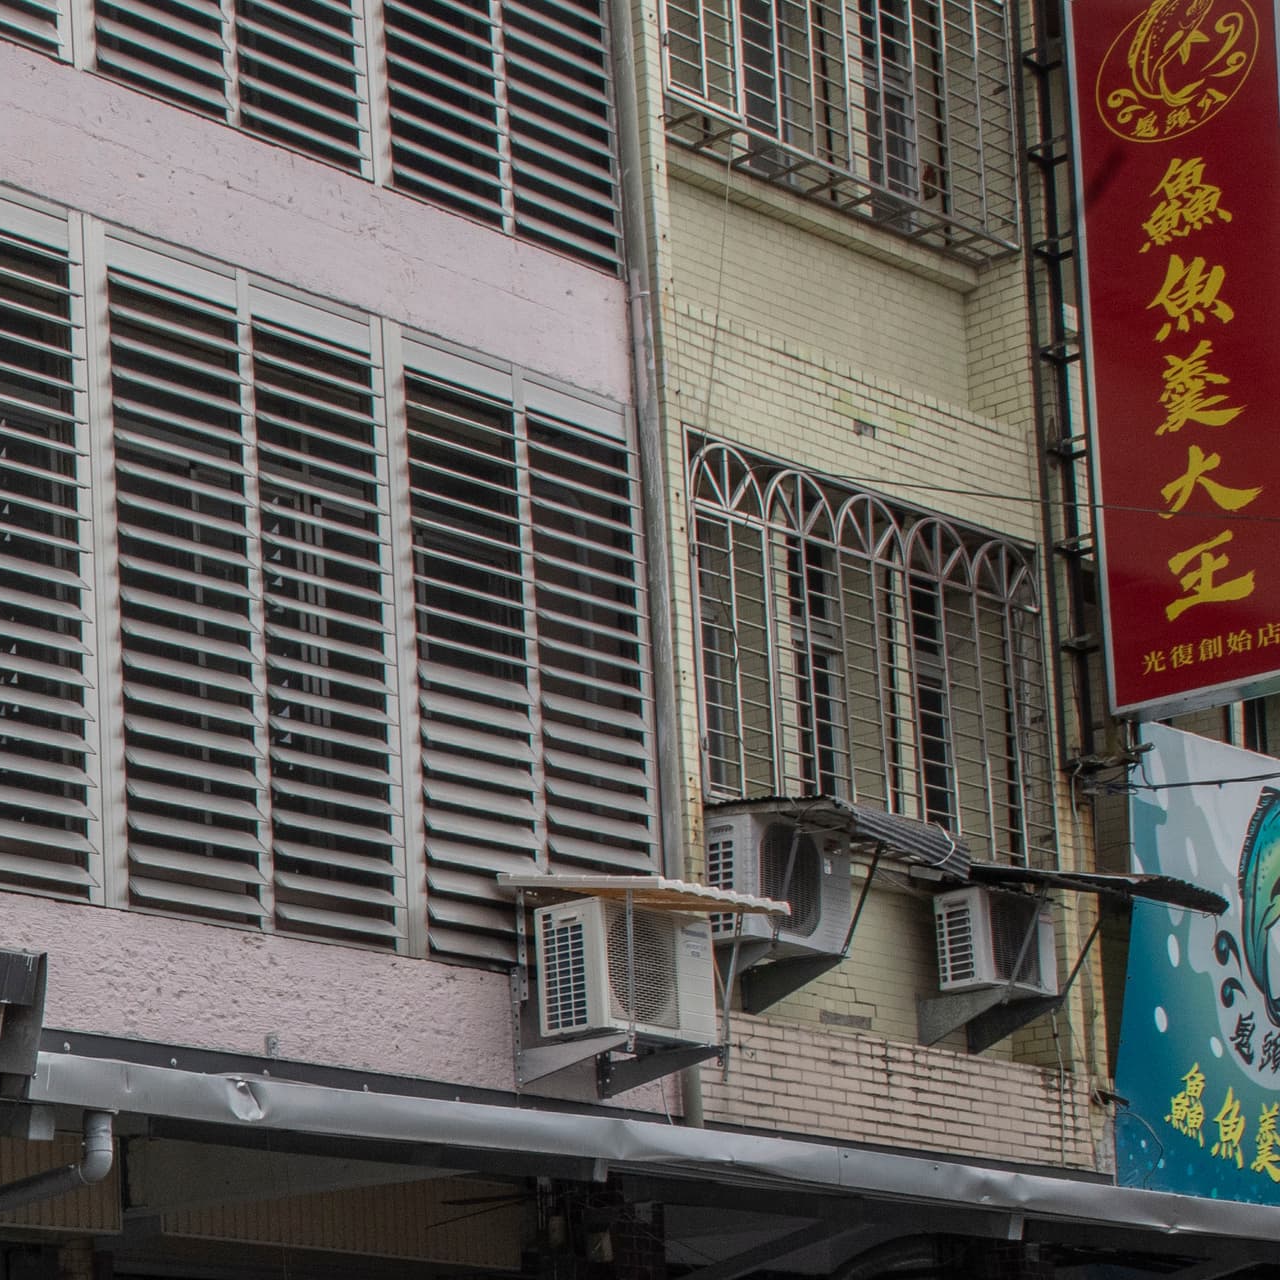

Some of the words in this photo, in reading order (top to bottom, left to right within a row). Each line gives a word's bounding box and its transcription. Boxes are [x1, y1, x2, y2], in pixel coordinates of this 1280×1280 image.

[1142, 623, 1280, 676] 光復創始店
